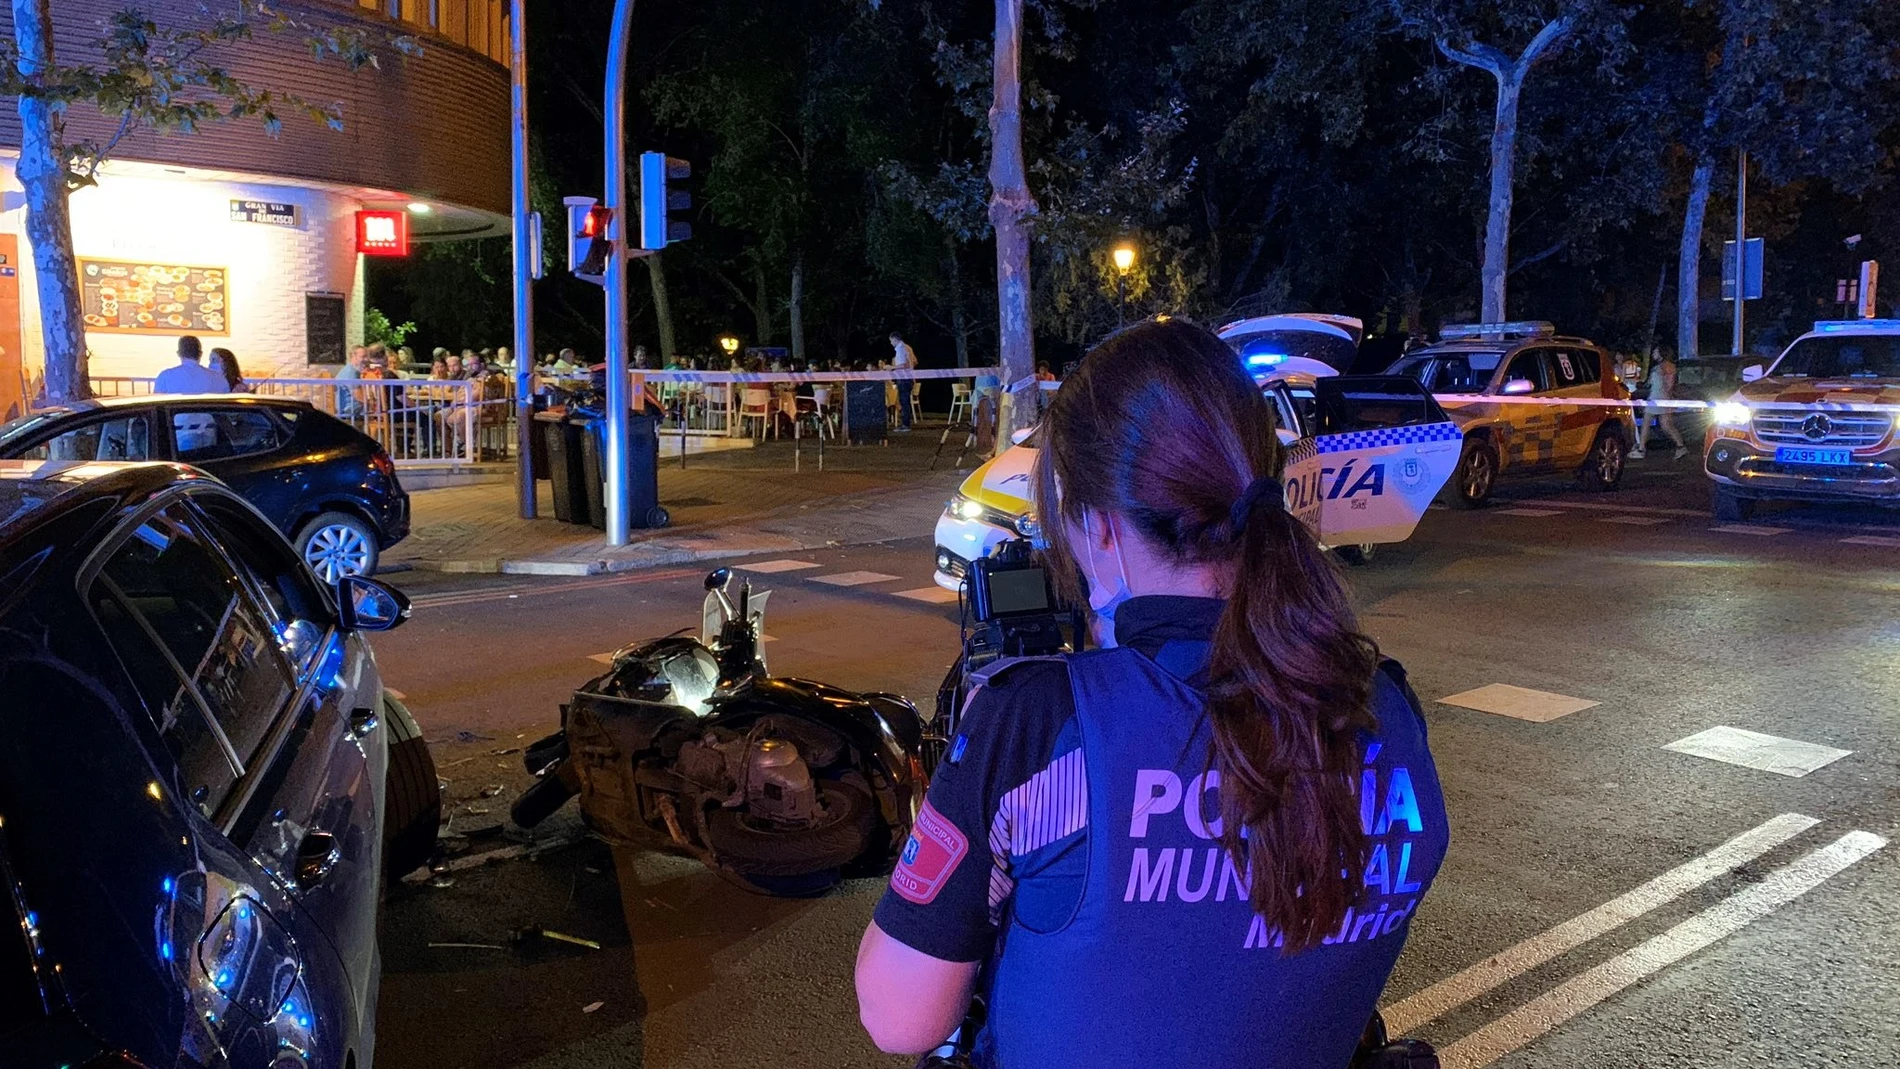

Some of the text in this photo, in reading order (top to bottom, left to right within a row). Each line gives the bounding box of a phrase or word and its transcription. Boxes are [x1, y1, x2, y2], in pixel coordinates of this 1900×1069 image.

[231, 211, 294, 225] SAN FRANCISCO
[245, 201, 266, 209] GRAN
[1785, 450, 1846, 463] 2495 LKX
[1285, 458, 1385, 511] OLICÍA
[1129, 744, 1423, 839] POÍA
[1124, 842, 1421, 902] MUNAL
